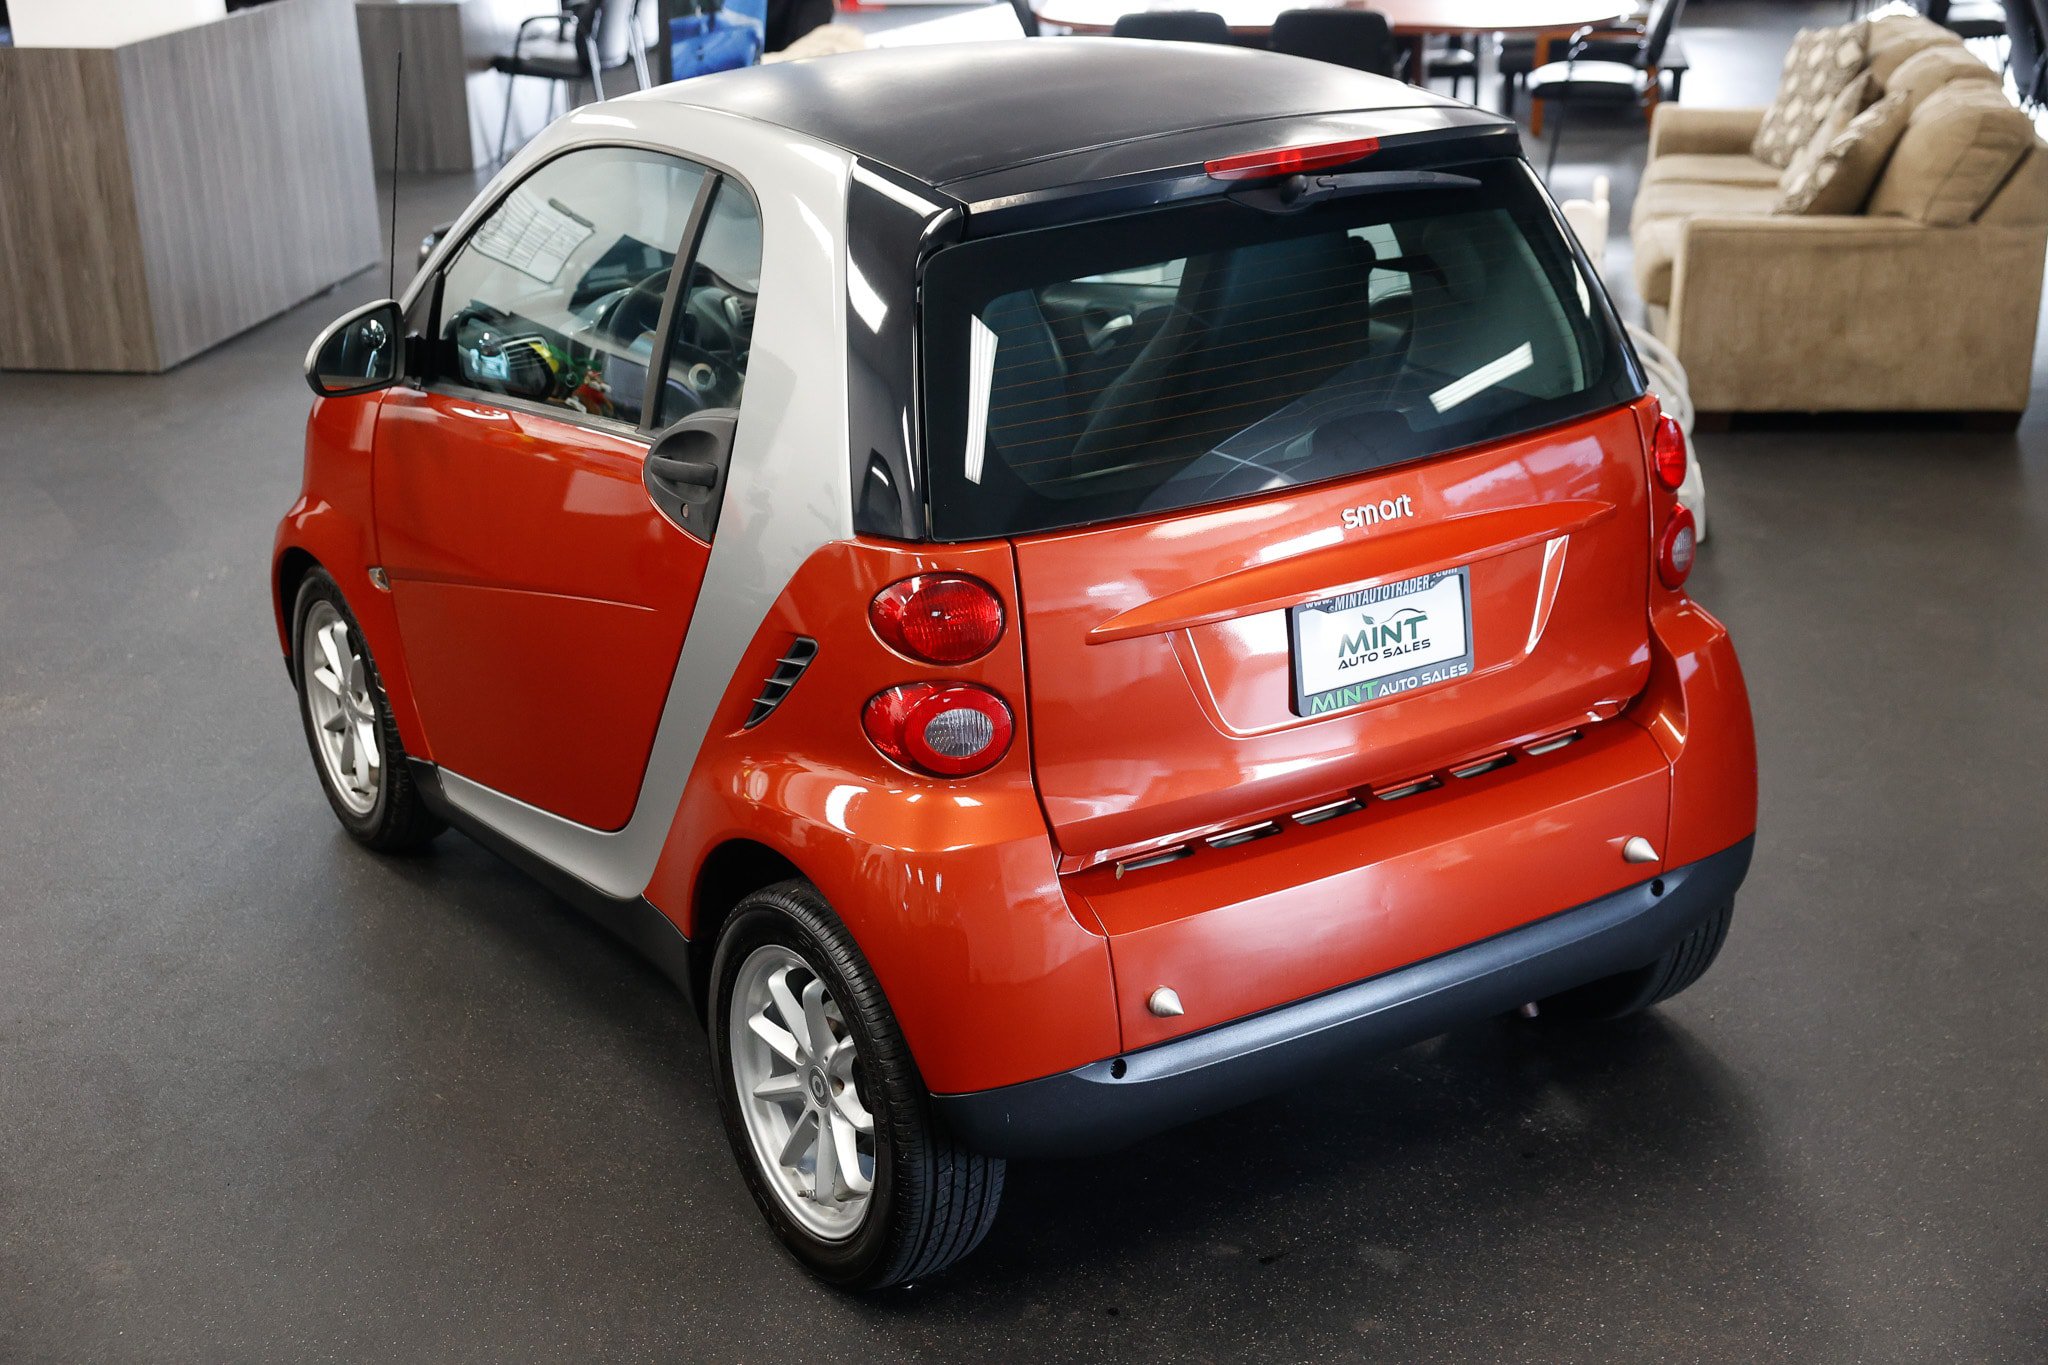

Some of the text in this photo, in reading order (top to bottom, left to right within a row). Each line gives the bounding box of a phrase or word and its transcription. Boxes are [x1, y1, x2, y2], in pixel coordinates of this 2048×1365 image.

[1342, 493, 1414, 530] smart
[1334, 574, 1431, 612] MINTAUTOTRADER
[1338, 613, 1428, 658] MINT
[1338, 638, 1431, 670] AUTO SALES
[1310, 662, 1469, 715] MINT AUTO SALES
